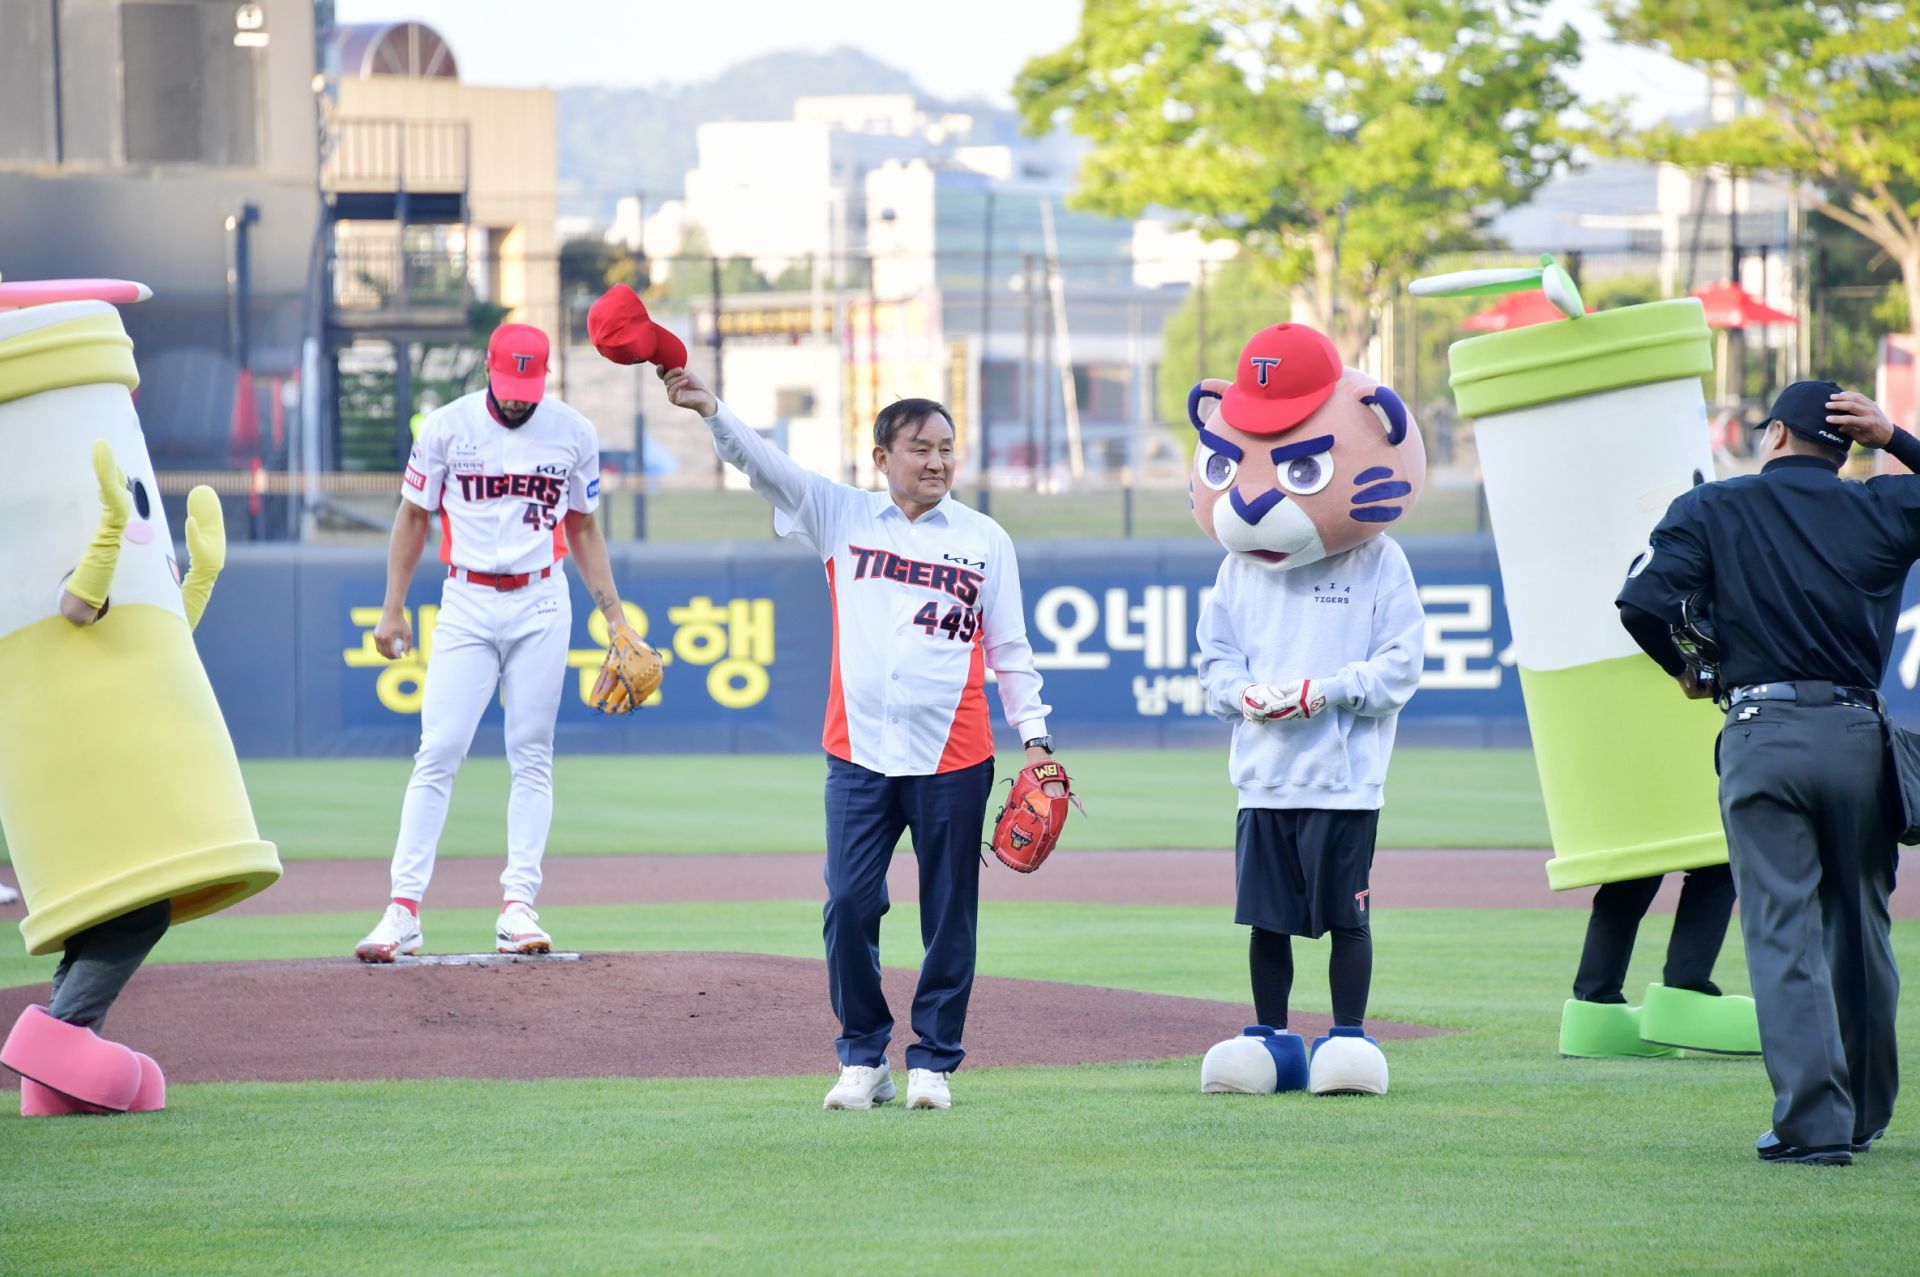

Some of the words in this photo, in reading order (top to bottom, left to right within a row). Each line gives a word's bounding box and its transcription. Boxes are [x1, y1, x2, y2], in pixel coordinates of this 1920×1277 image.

[512, 353, 534, 373] T
[1251, 357, 1282, 387] T
[456, 473, 566, 507] TIGERS
[522, 503, 558, 531] 45
[848, 544, 986, 607] TIGERS
[1314, 596, 1350, 605] TIGERS
[912, 601, 977, 643] 449
